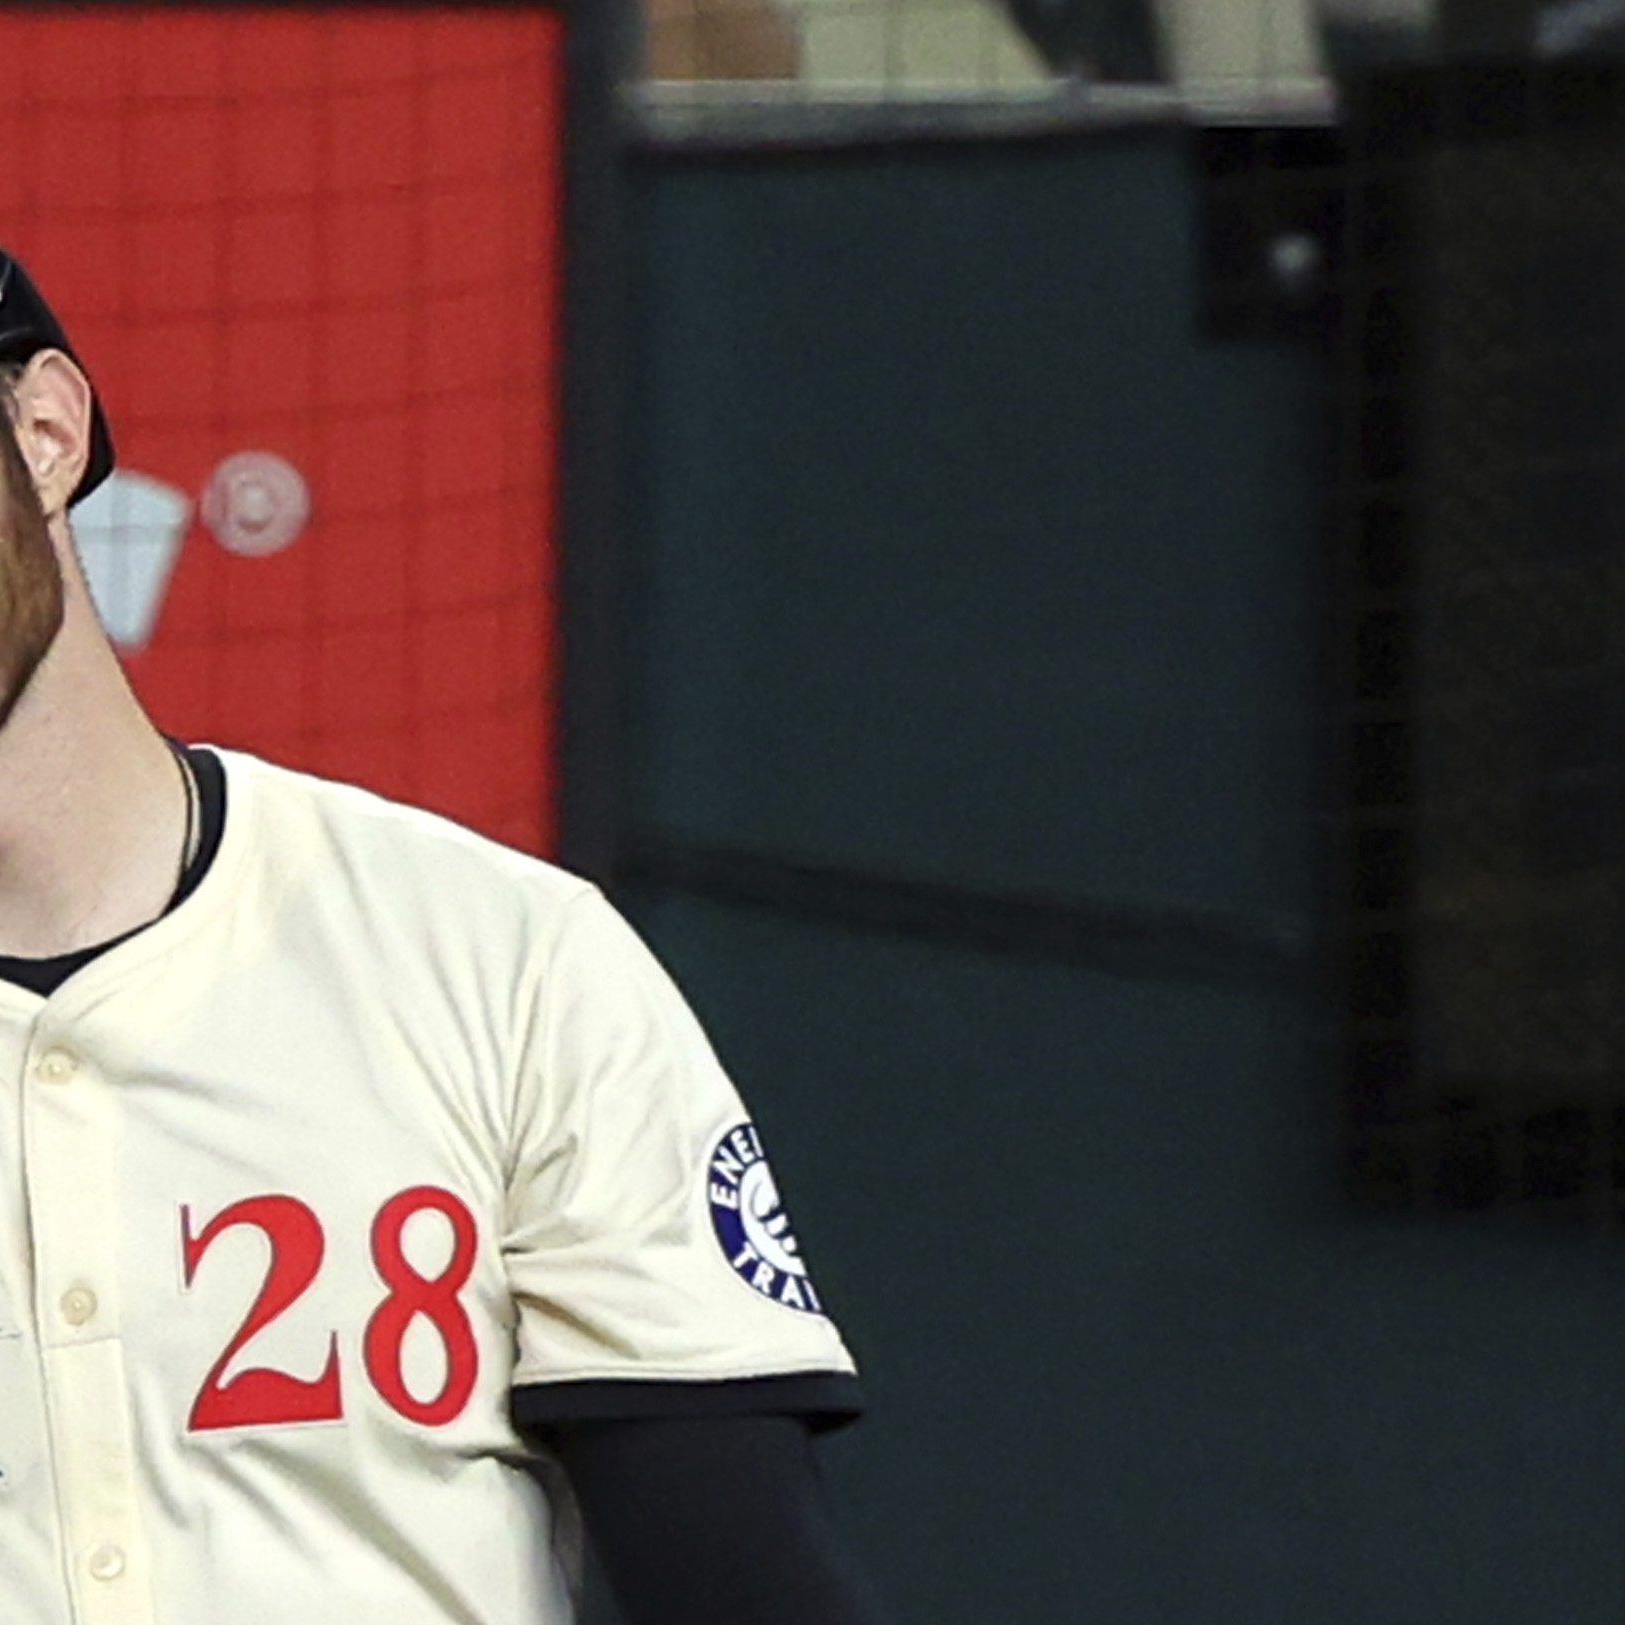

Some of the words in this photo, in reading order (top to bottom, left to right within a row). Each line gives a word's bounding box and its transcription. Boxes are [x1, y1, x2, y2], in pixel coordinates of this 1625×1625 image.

[710, 1126, 764, 1211] ENE
[178, 1184, 480, 1432] 28
[733, 1240, 821, 1312] TRA
